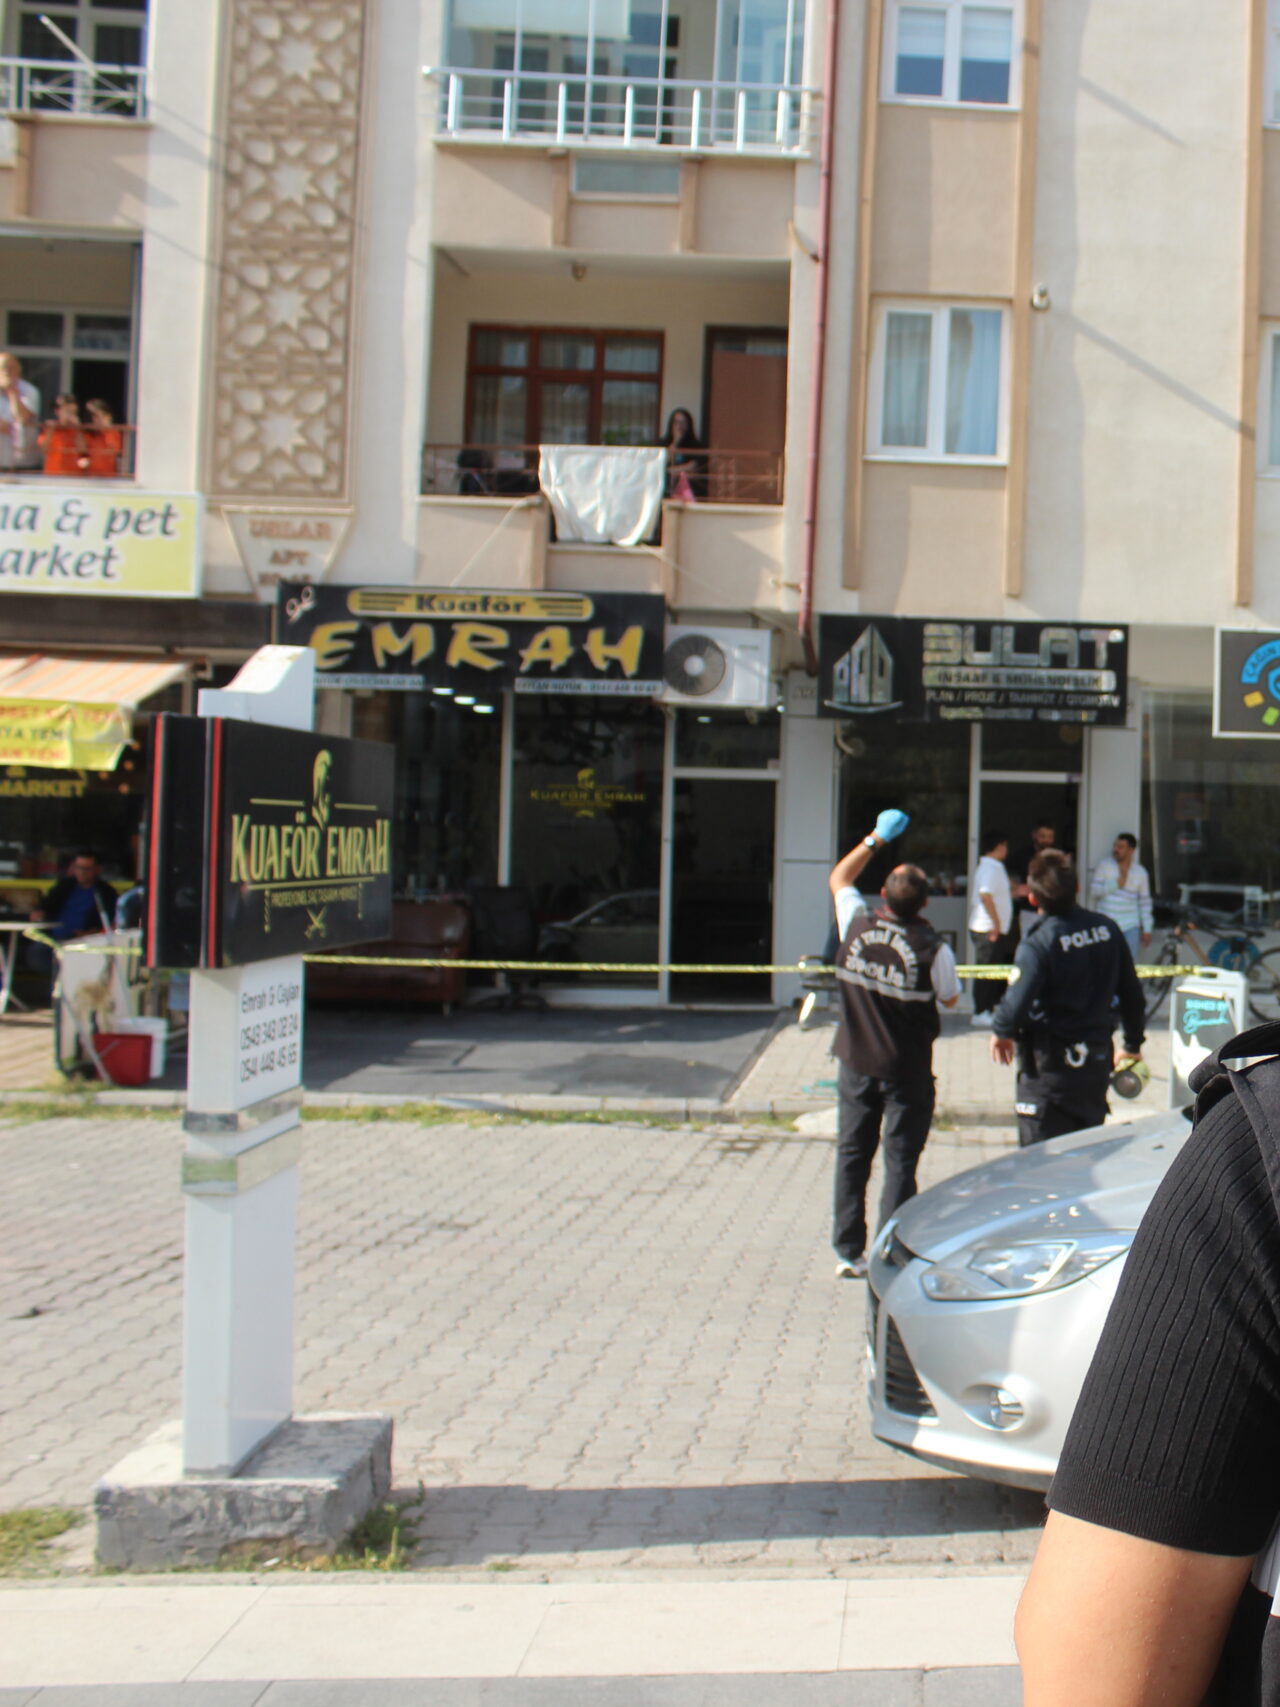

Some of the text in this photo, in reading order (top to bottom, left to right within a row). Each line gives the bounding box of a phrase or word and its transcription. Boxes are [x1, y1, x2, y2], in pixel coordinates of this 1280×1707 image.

[54, 499, 90, 536] &
[103, 503, 177, 540] pet
[309, 620, 645, 678] EMRAH
[923, 623, 1124, 668] BULAT
[230, 811, 391, 883] KUAFÖR EMRAH
